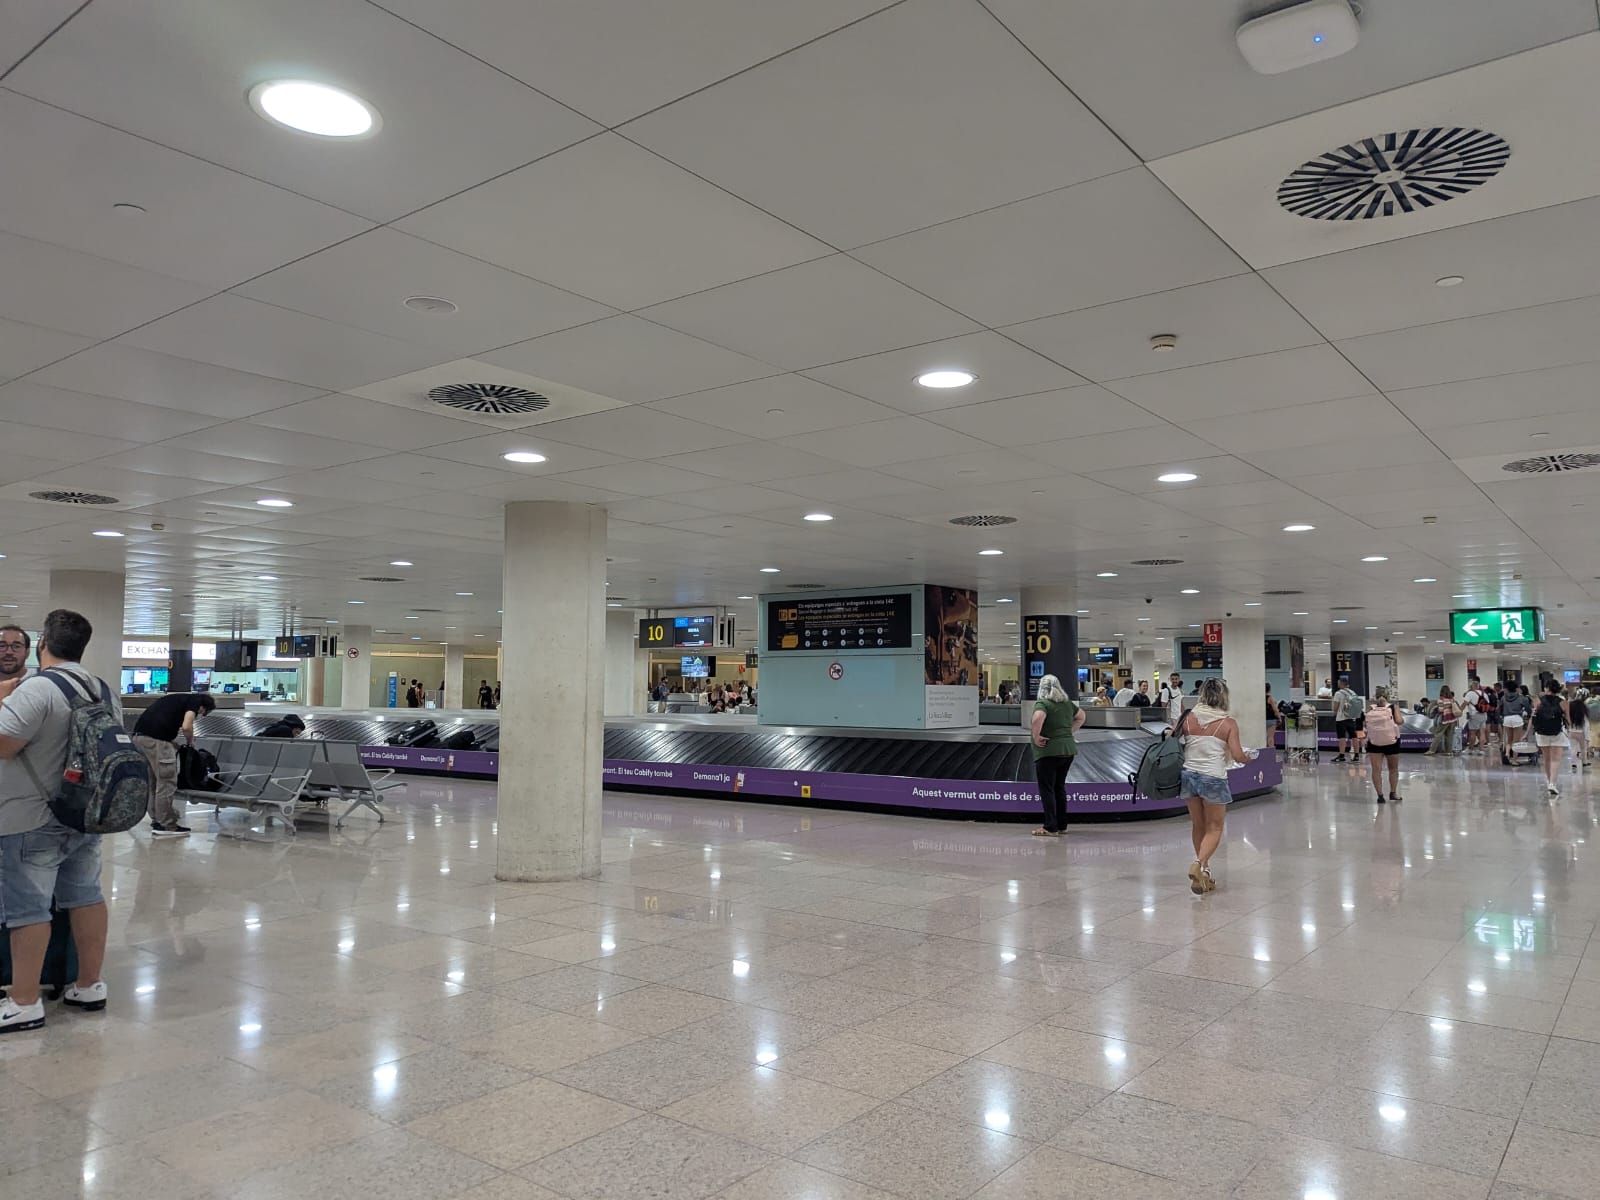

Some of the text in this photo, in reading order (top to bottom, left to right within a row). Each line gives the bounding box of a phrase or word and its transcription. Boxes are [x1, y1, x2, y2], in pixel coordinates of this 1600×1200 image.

[648, 625, 664, 641] 10
[279, 642, 288, 653] 10
[1026, 634, 1051, 654] 10
[127, 645, 169, 655] EXCHAN
[1336, 661, 1352, 672] 11
[618, 767, 623, 775] El
[634, 768, 653, 778] Cabify
[654, 770, 673, 778] també
[912, 787, 941, 799] Aquest
[943, 790, 976, 800] vermut
[978, 791, 1001, 801] amb
[1003, 792, 1017, 801] els
[1019, 791, 1032, 801] de
[1073, 792, 1097, 802] t'està
